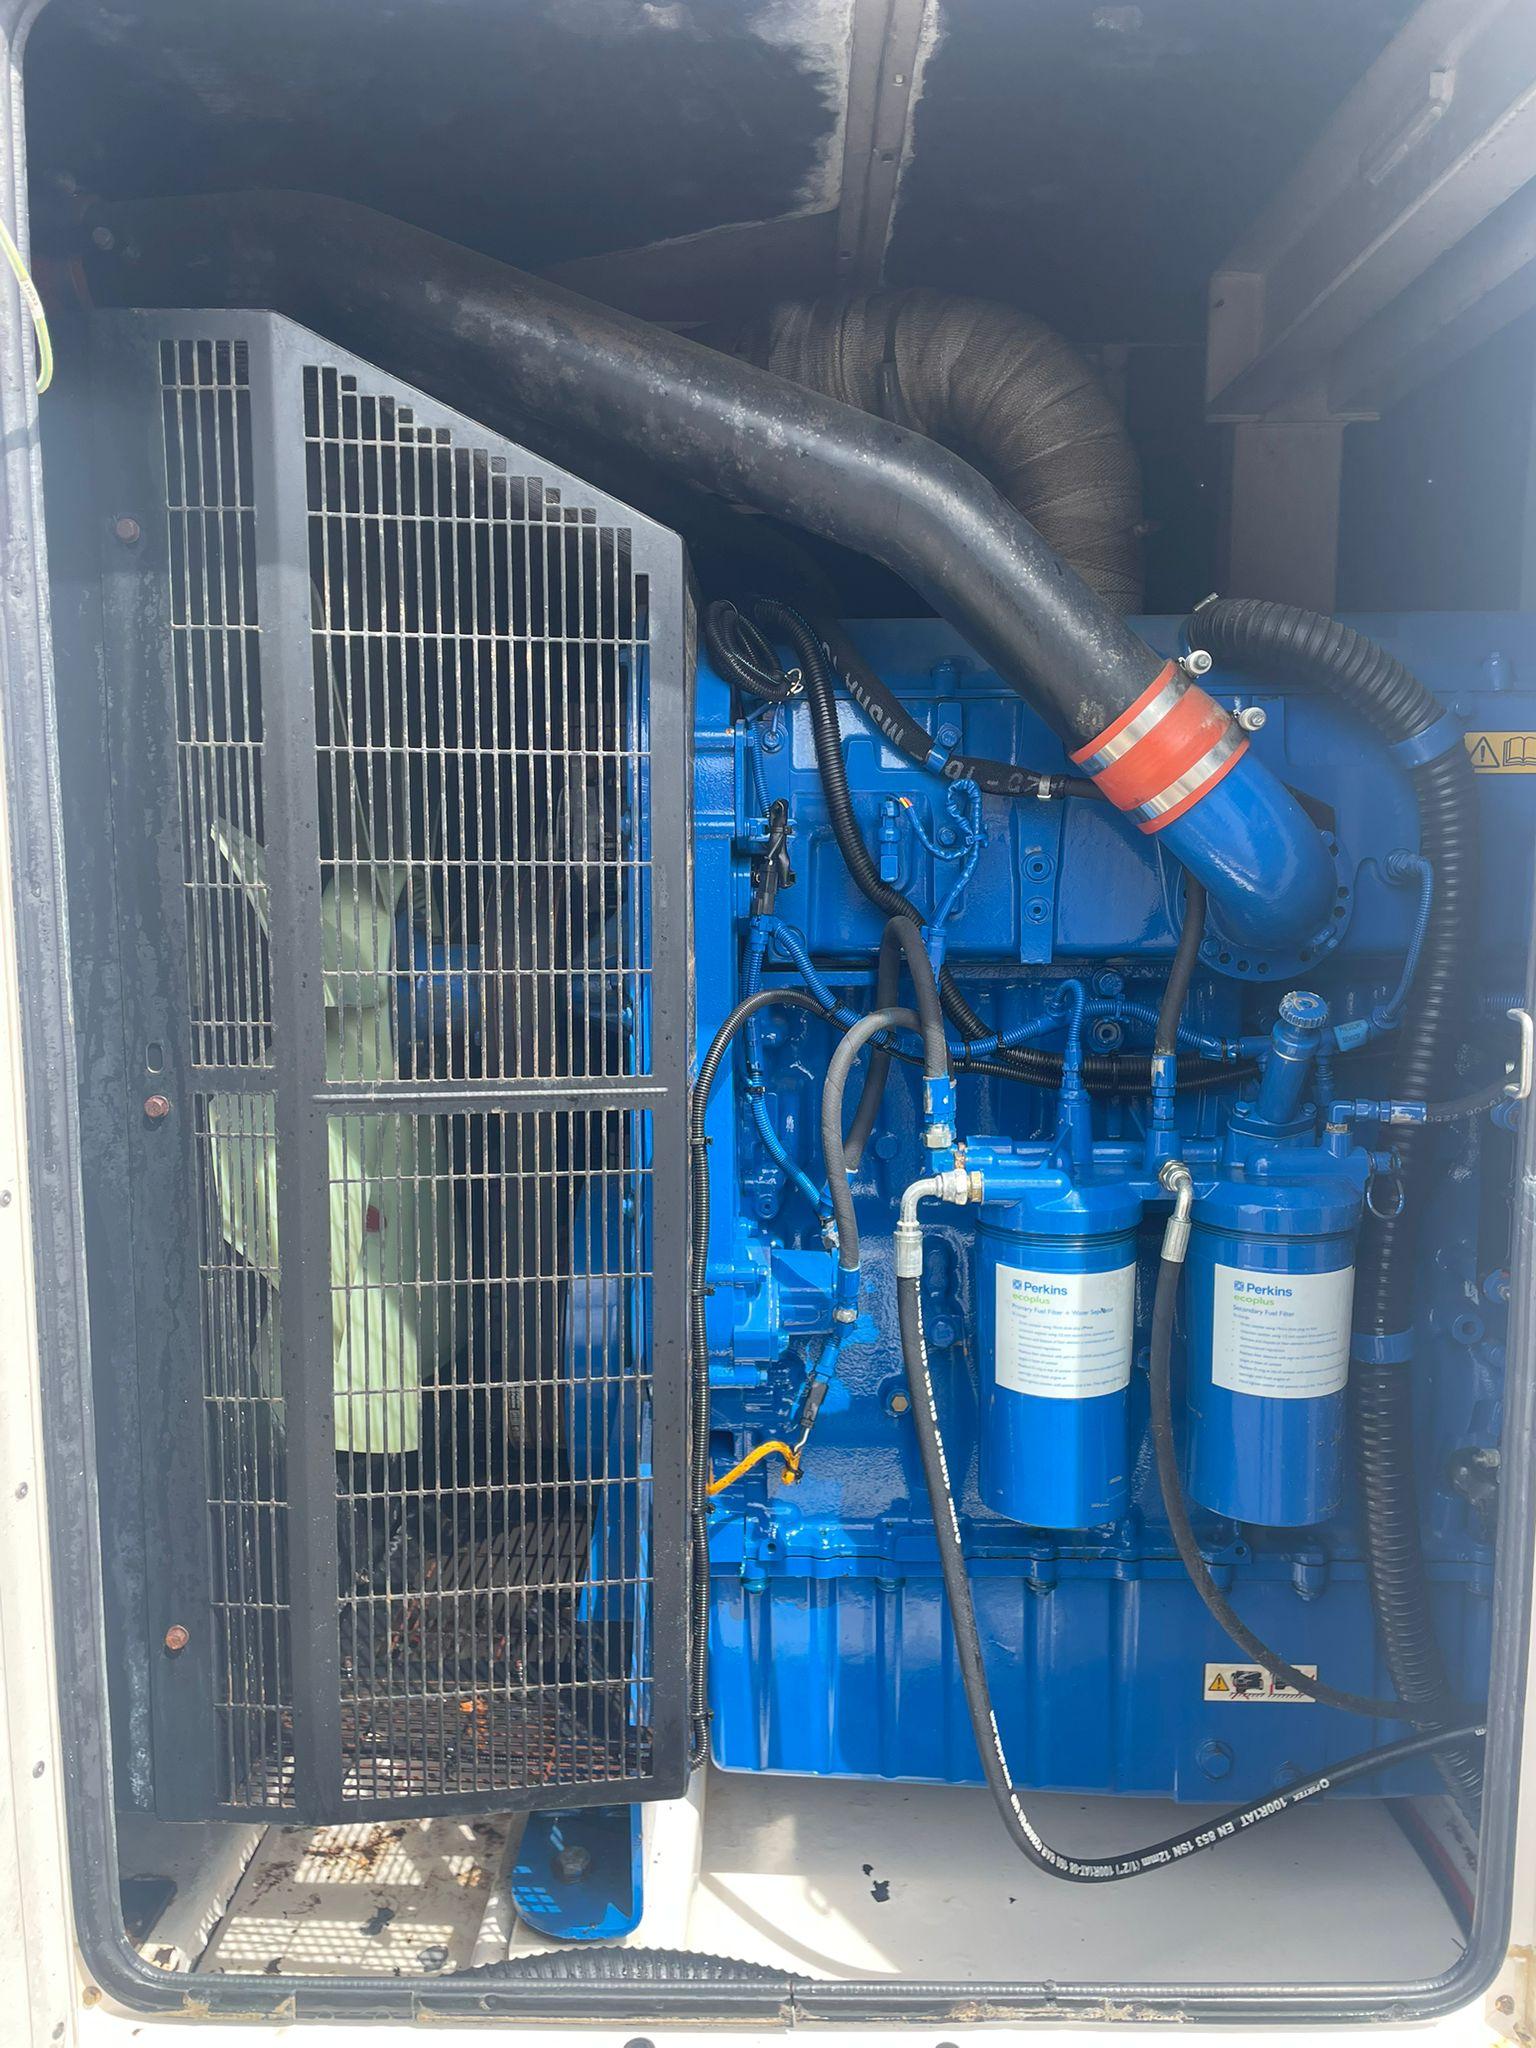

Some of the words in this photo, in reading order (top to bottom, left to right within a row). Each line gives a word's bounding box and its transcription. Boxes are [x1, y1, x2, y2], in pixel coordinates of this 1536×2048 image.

[1024, 1281, 1068, 1296] Perkins
[1246, 1282, 1294, 1298] Perkins
[1012, 1293, 1051, 1305] ecoplus
[1233, 1294, 1275, 1307] ecoplus
[1034, 1307, 1047, 1315] Fuel
[1232, 1304, 1264, 1316] Secondary
[1279, 1310, 1296, 1318] Filter
[1239, 1797, 1288, 1828] 100R1AT
[1216, 1821, 1236, 1838] EN
[1194, 1830, 1216, 1847] 853
[1171, 1840, 1195, 1857] 1SN
[1140, 1850, 1172, 1867] 12mm
